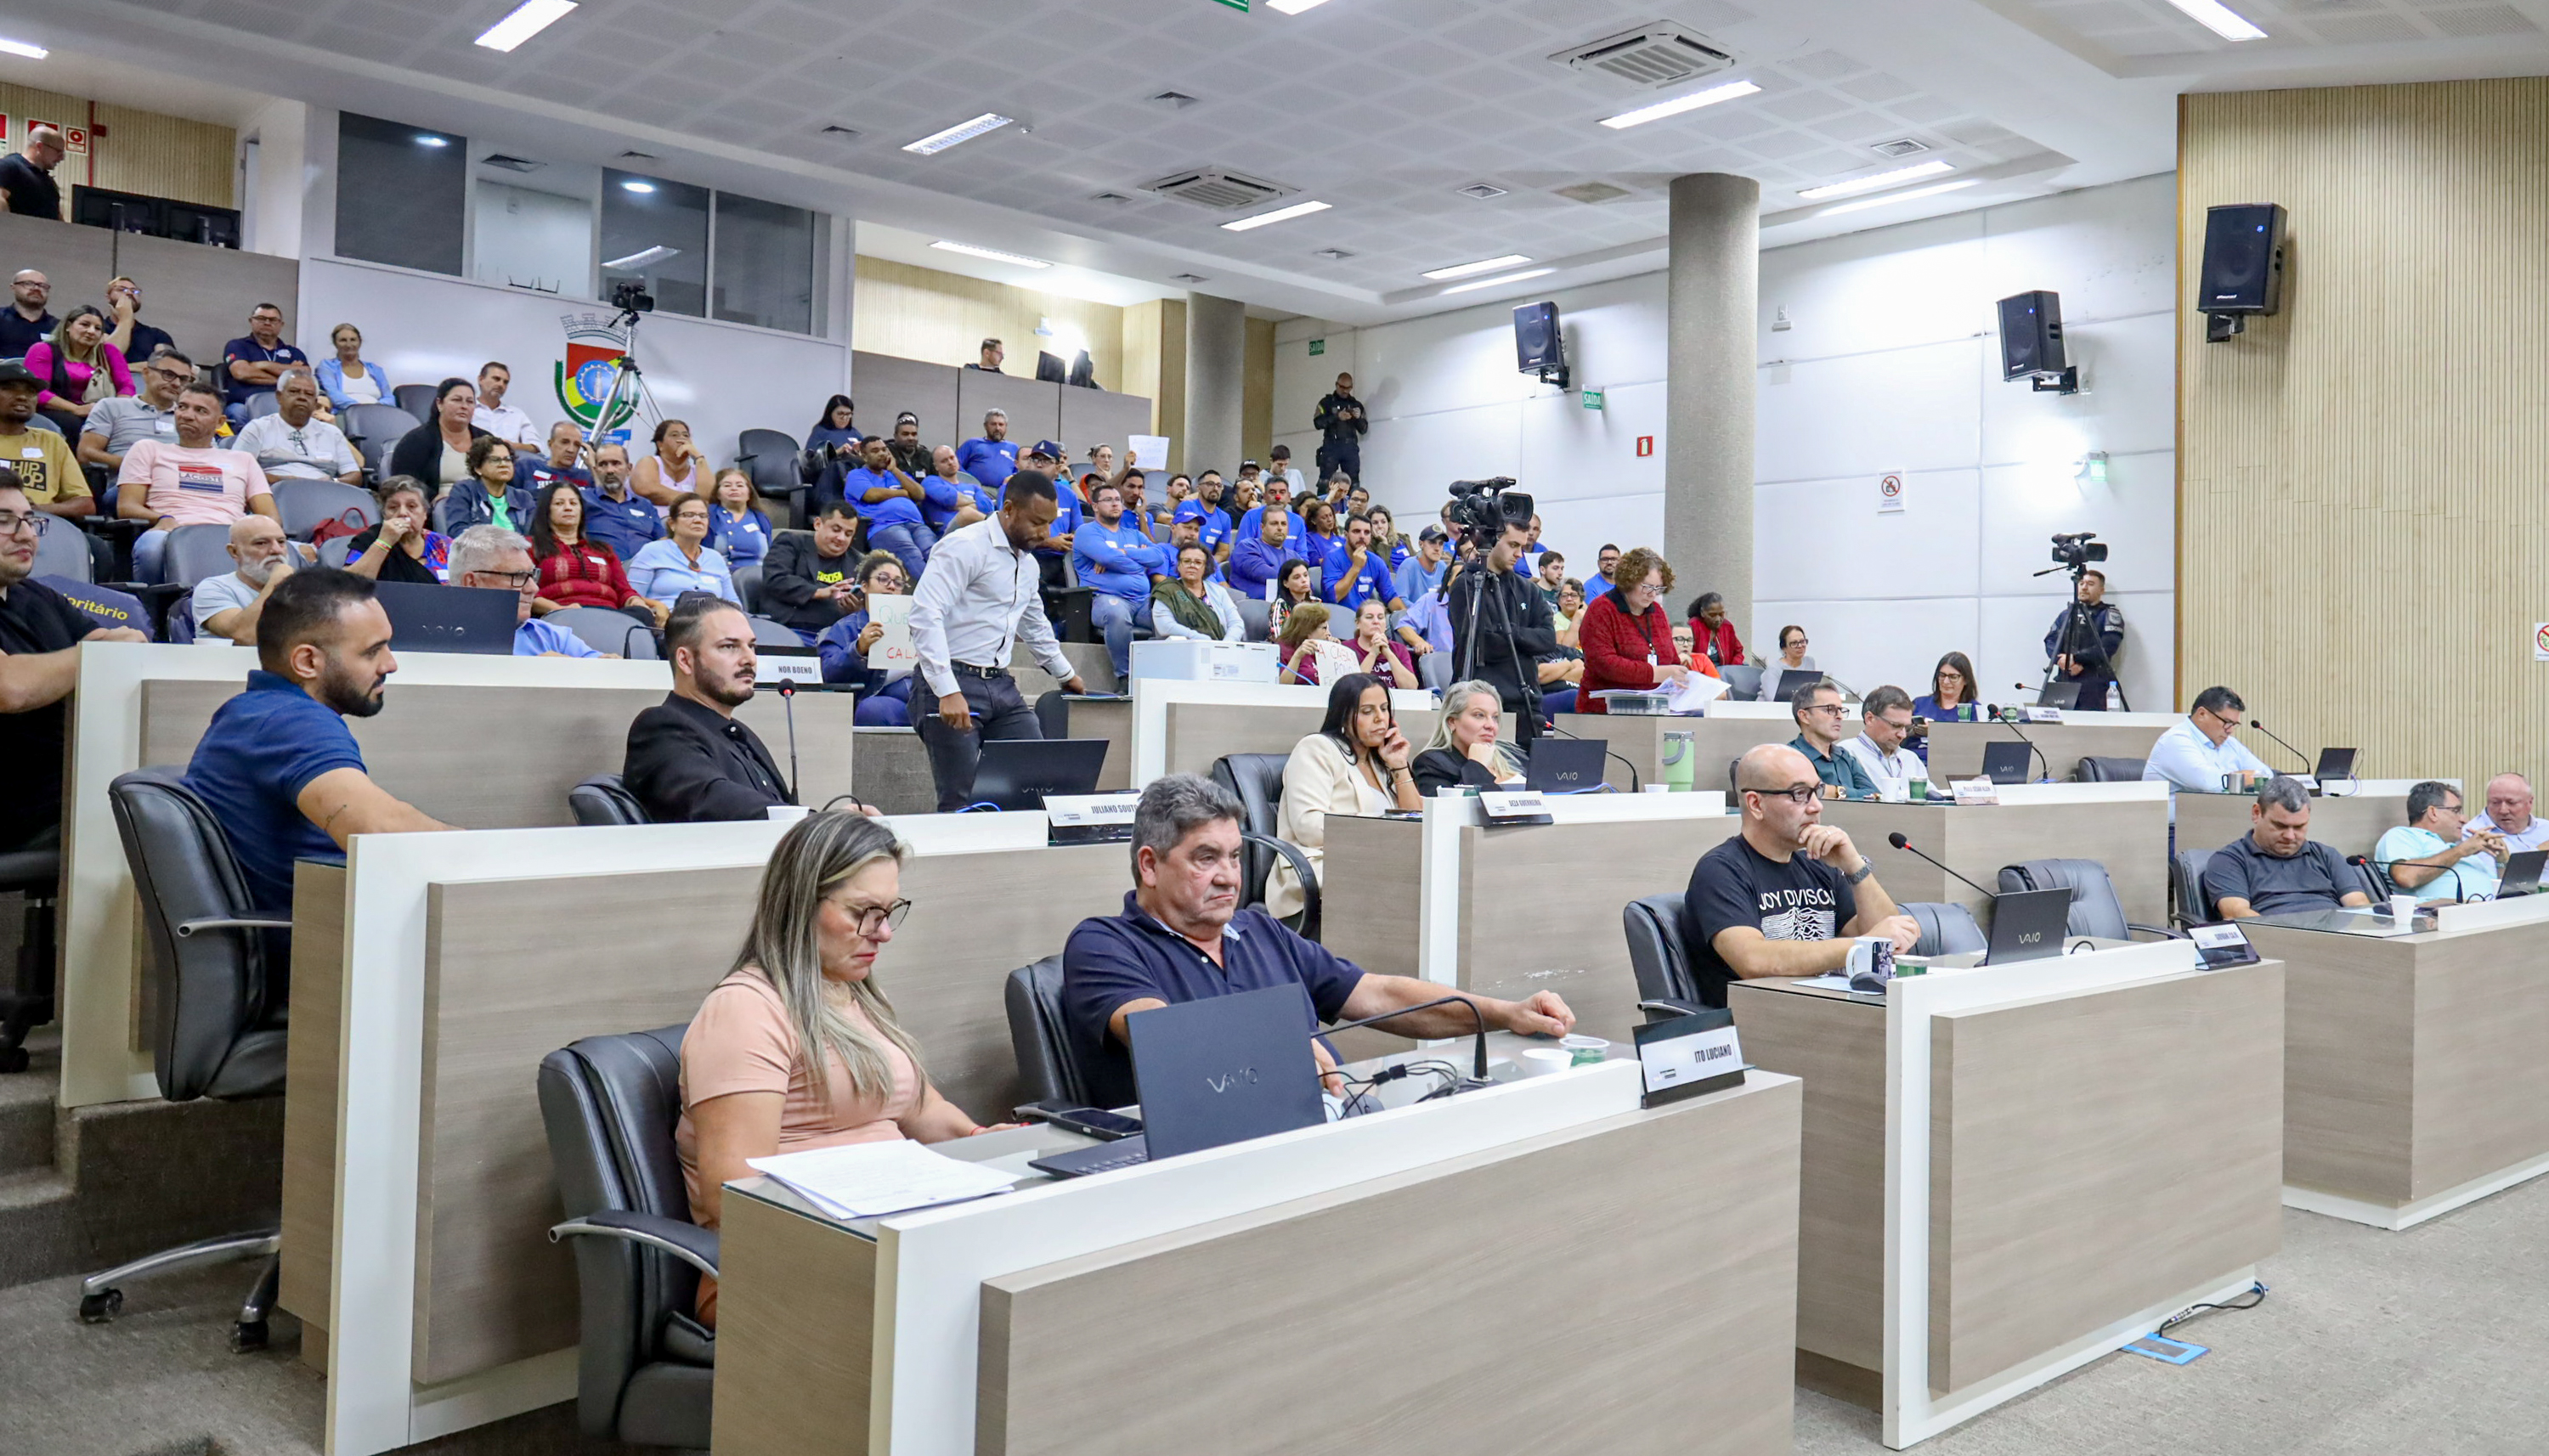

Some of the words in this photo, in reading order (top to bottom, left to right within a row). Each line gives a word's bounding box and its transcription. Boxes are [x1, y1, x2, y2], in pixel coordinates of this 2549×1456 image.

[11, 461, 41, 476] HIP
[21, 471, 45, 488] OP
[67, 596, 128, 620] oritário
[1556, 771, 1579, 781] VAIO
[1091, 805, 1117, 814] JULIANO
[1759, 890, 1783, 911] JOY
[2018, 931, 2041, 944] VAIO
[1694, 1049, 1706, 1064] ITO
[1705, 1043, 1732, 1061] LUCIANO
[1207, 1067, 1258, 1093] VAIO
